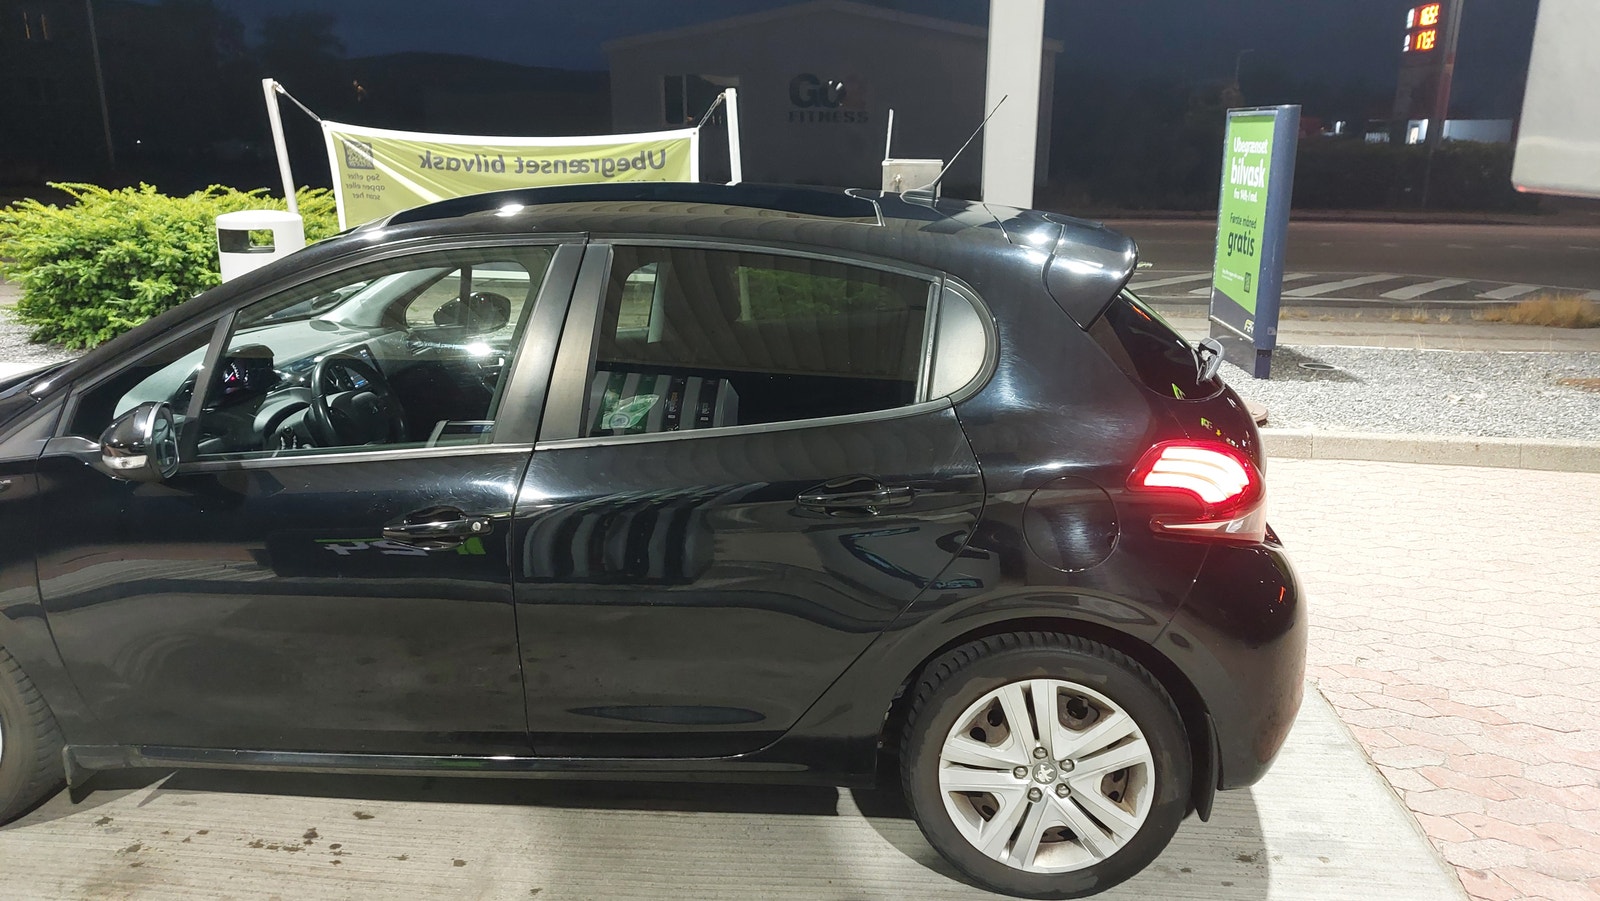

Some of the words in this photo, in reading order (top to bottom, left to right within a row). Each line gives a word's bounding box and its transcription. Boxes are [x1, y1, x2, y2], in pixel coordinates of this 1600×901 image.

[788, 111, 869, 123] FITNESS
[1233, 136, 1268, 157] Ubegrænset
[1230, 156, 1266, 189] bilvask
[1229, 212, 1242, 226] Første
[1242, 215, 1257, 229] måned
[1227, 230, 1255, 257] gratis
